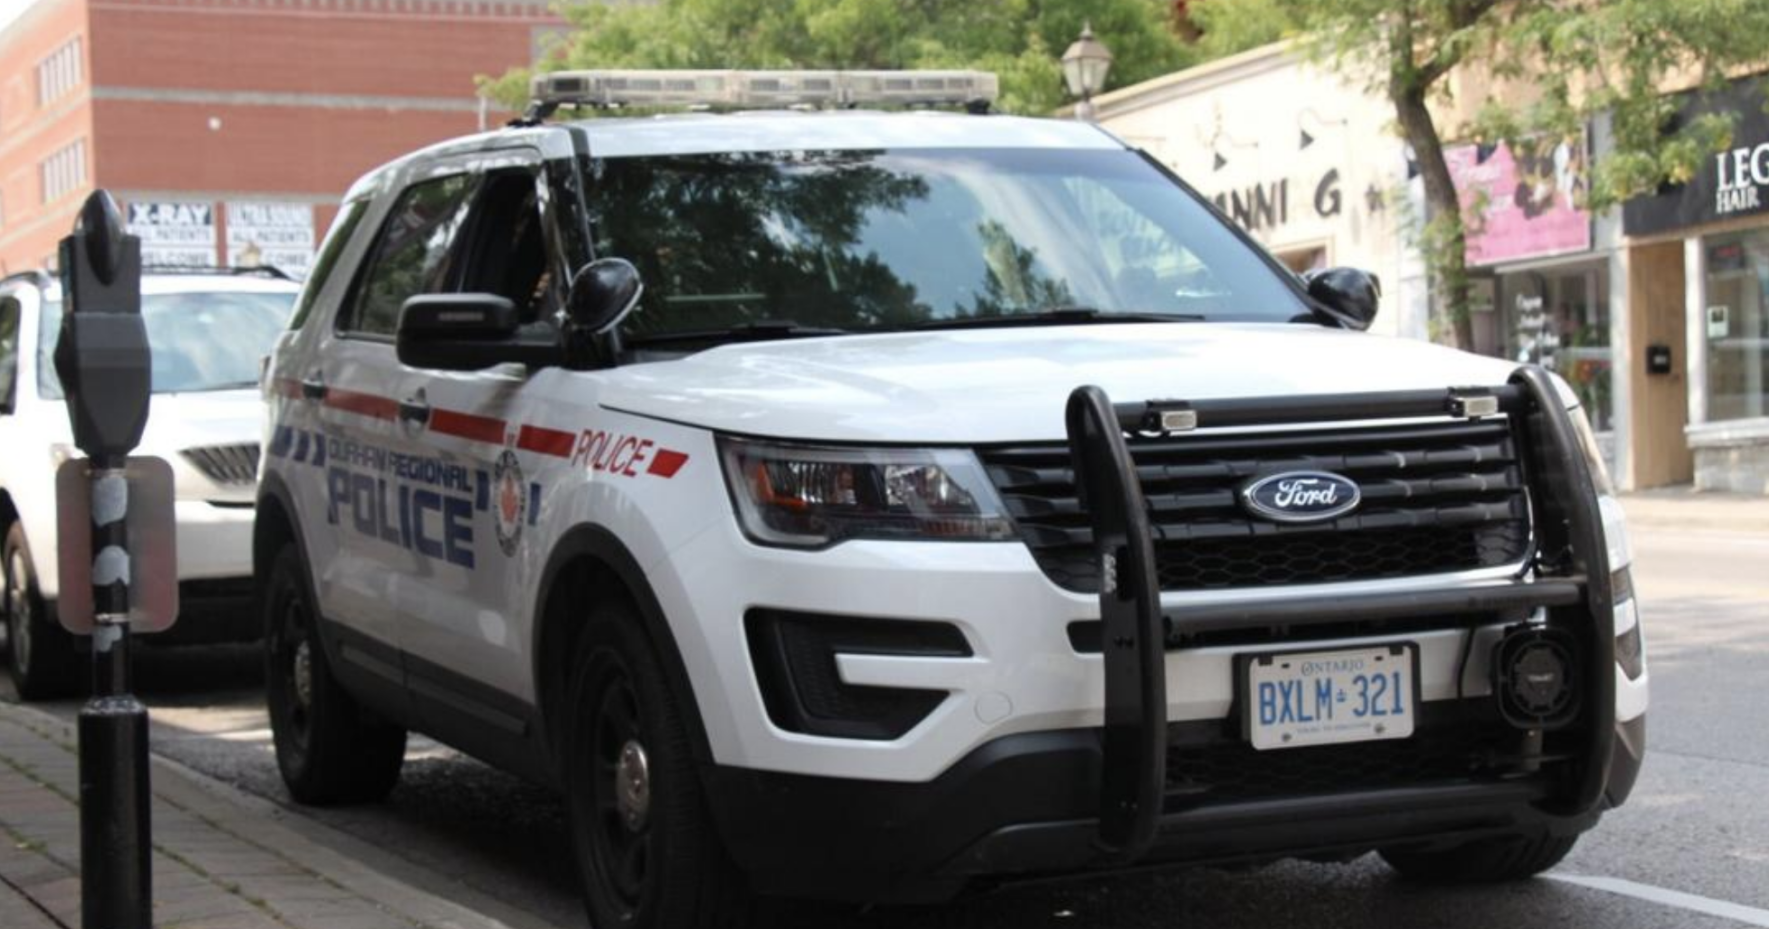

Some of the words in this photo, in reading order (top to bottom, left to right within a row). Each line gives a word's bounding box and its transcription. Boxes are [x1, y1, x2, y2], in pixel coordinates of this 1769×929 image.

[1313, 167, 1342, 219] G
[1715, 186, 1761, 215] HAIR
[132, 203, 209, 225] X-RAY
[571, 428, 654, 478] POLICE
[388, 450, 473, 493] REGIONAL
[1275, 478, 1338, 508] Ford
[327, 465, 476, 570] POLICE
[1301, 659, 1364, 676] ONTARIO
